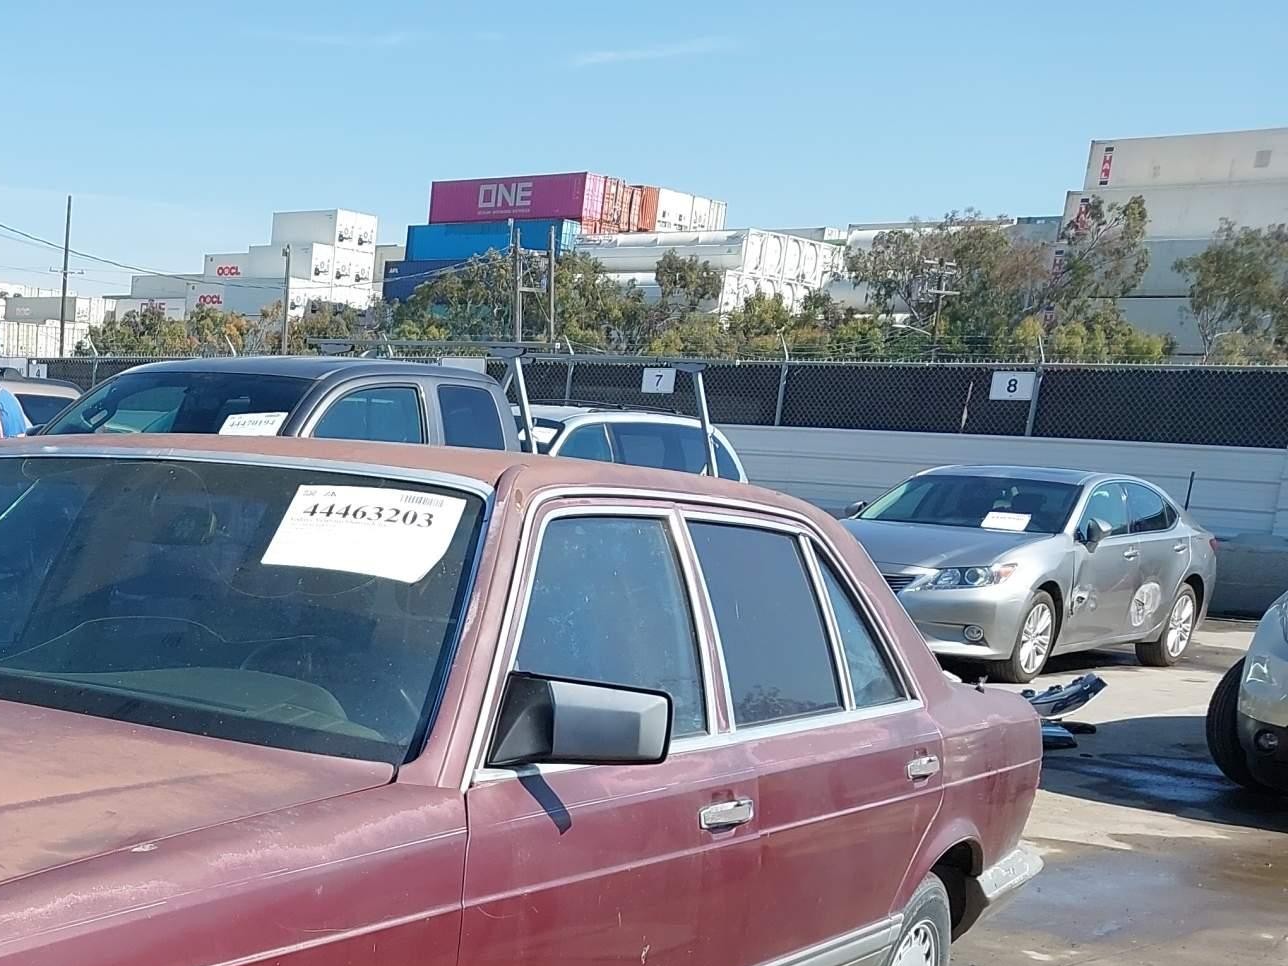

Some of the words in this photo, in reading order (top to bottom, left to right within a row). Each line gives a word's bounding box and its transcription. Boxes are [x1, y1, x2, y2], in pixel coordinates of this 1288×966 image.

[478, 182, 533, 208] ONE
[216, 265, 241, 276] OOCL
[198, 294, 223, 305] OOCL
[655, 374, 664, 387] 7
[1006, 378, 1018, 393] 8
[303, 503, 434, 528] 44463203
